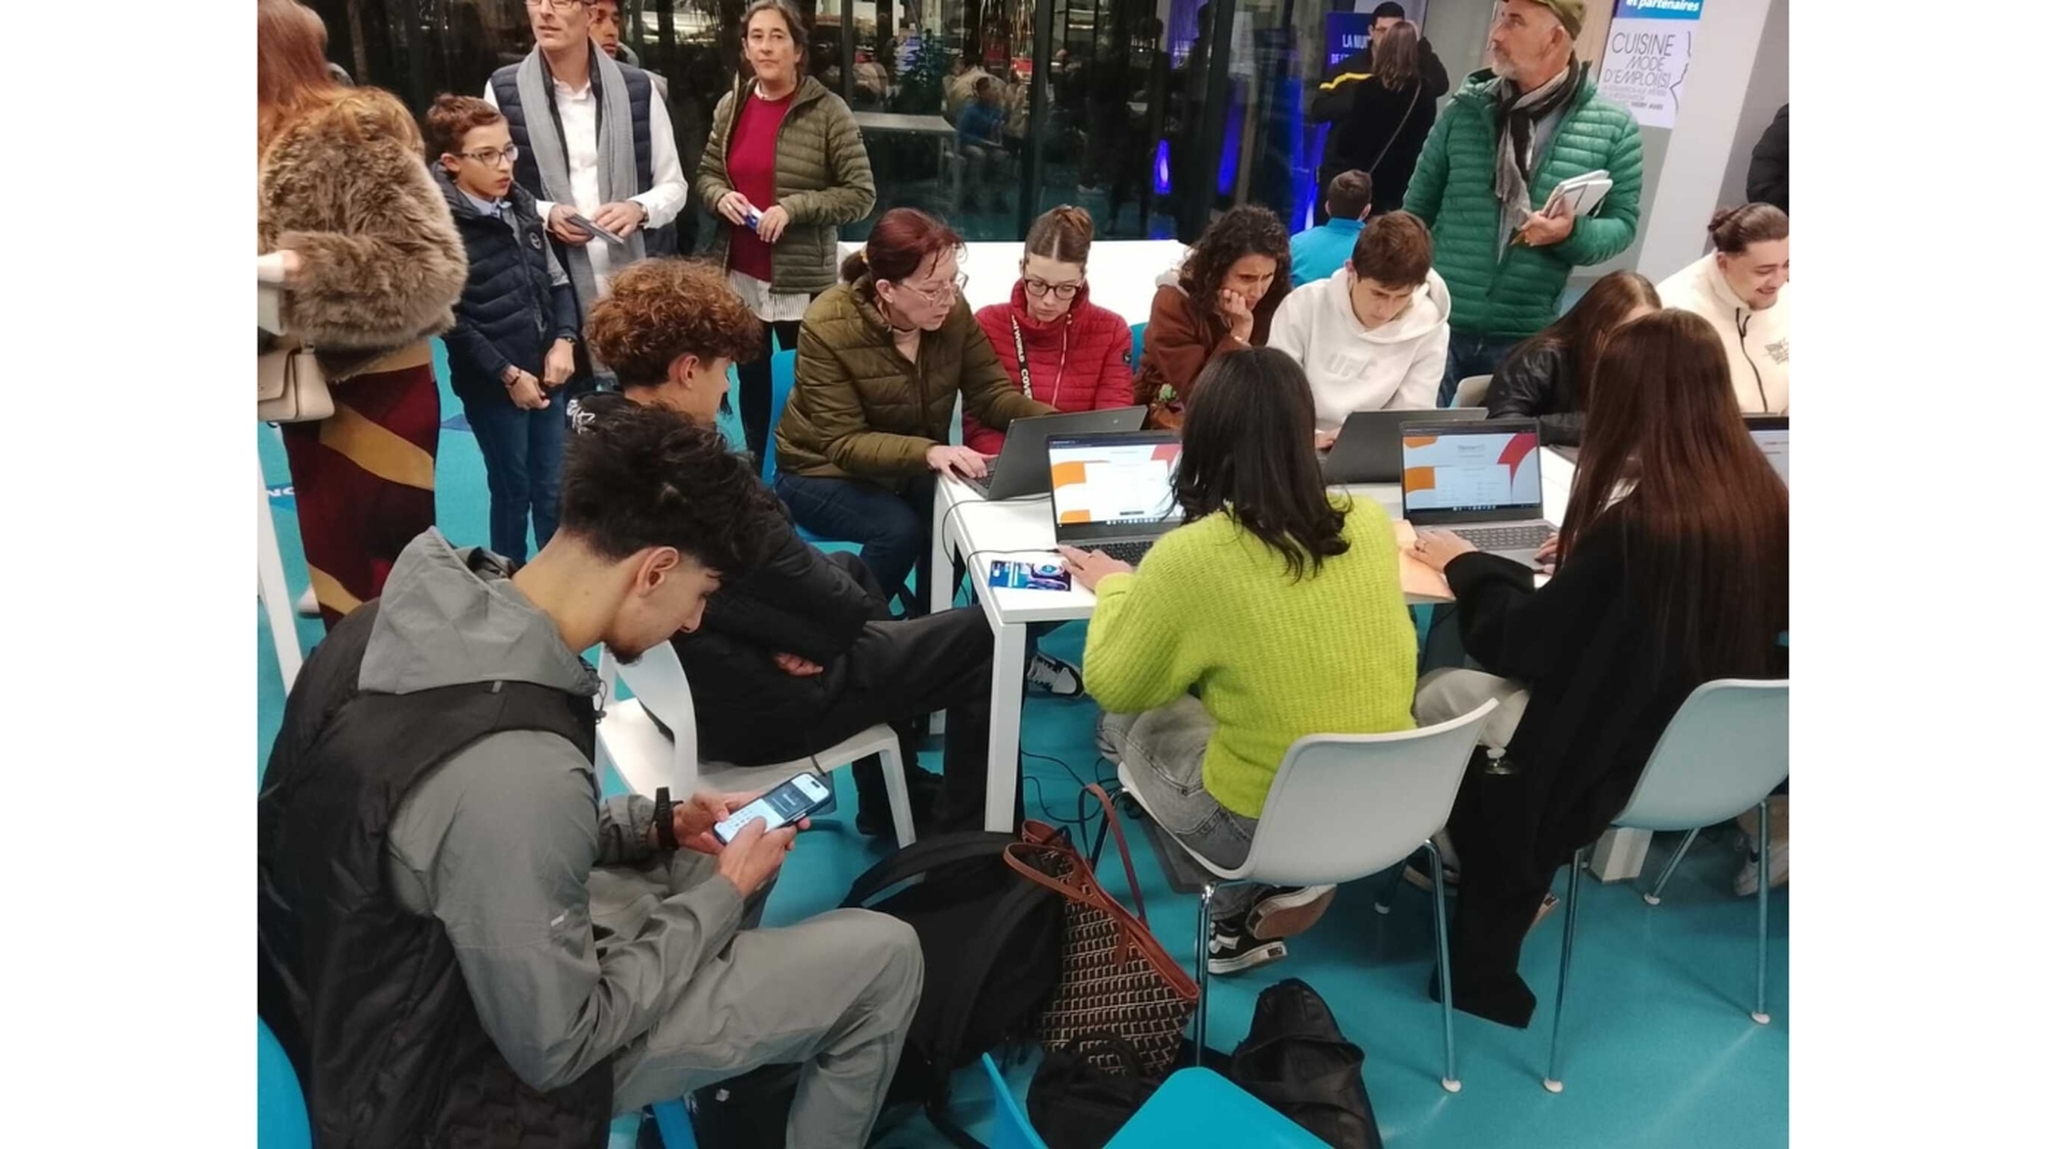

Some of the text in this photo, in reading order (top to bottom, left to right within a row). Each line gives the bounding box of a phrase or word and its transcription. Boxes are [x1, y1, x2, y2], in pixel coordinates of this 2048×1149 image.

[1637, 0, 1700, 12] partenaires
[1342, 34, 1352, 48] LA
[1611, 32, 1675, 56] CUISINE
[1626, 55, 1666, 71] MODE
[1603, 69, 1672, 89] D'EMPLOI(S)
[1325, 353, 1377, 382] UFC
